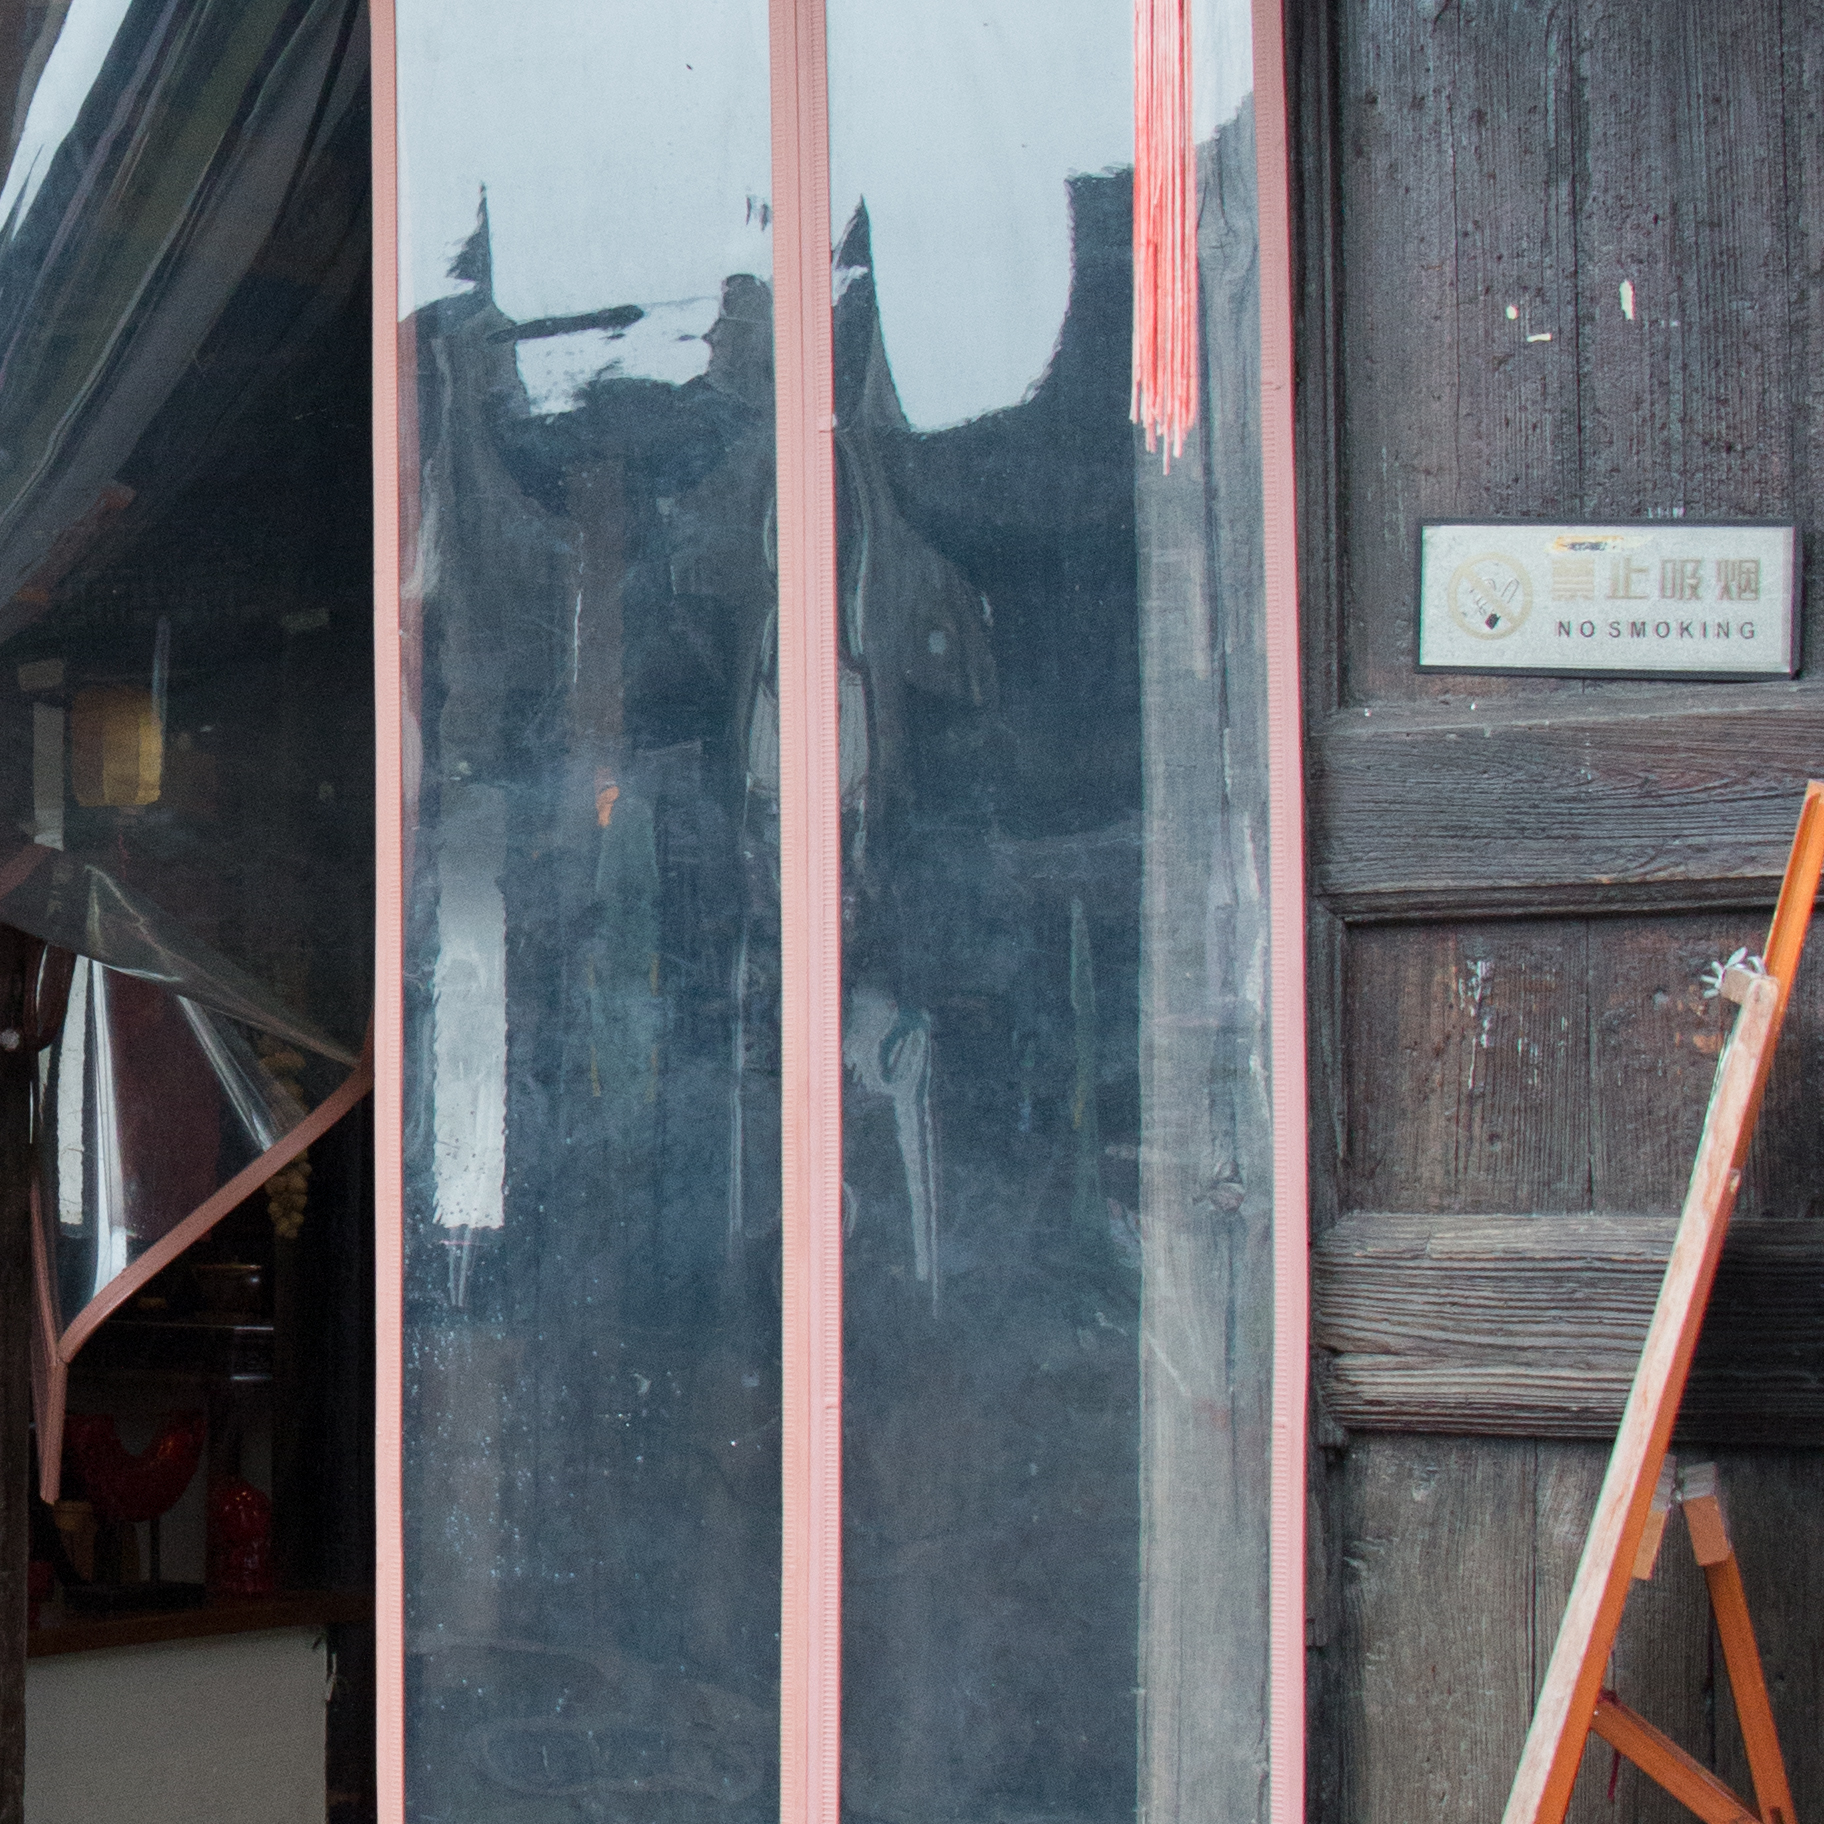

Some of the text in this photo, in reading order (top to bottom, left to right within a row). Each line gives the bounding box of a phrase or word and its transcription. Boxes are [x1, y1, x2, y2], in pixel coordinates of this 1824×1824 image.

[1550, 557, 1761, 602] 禁止吸烟
[1555, 620, 1757, 640] NO SMOKING
